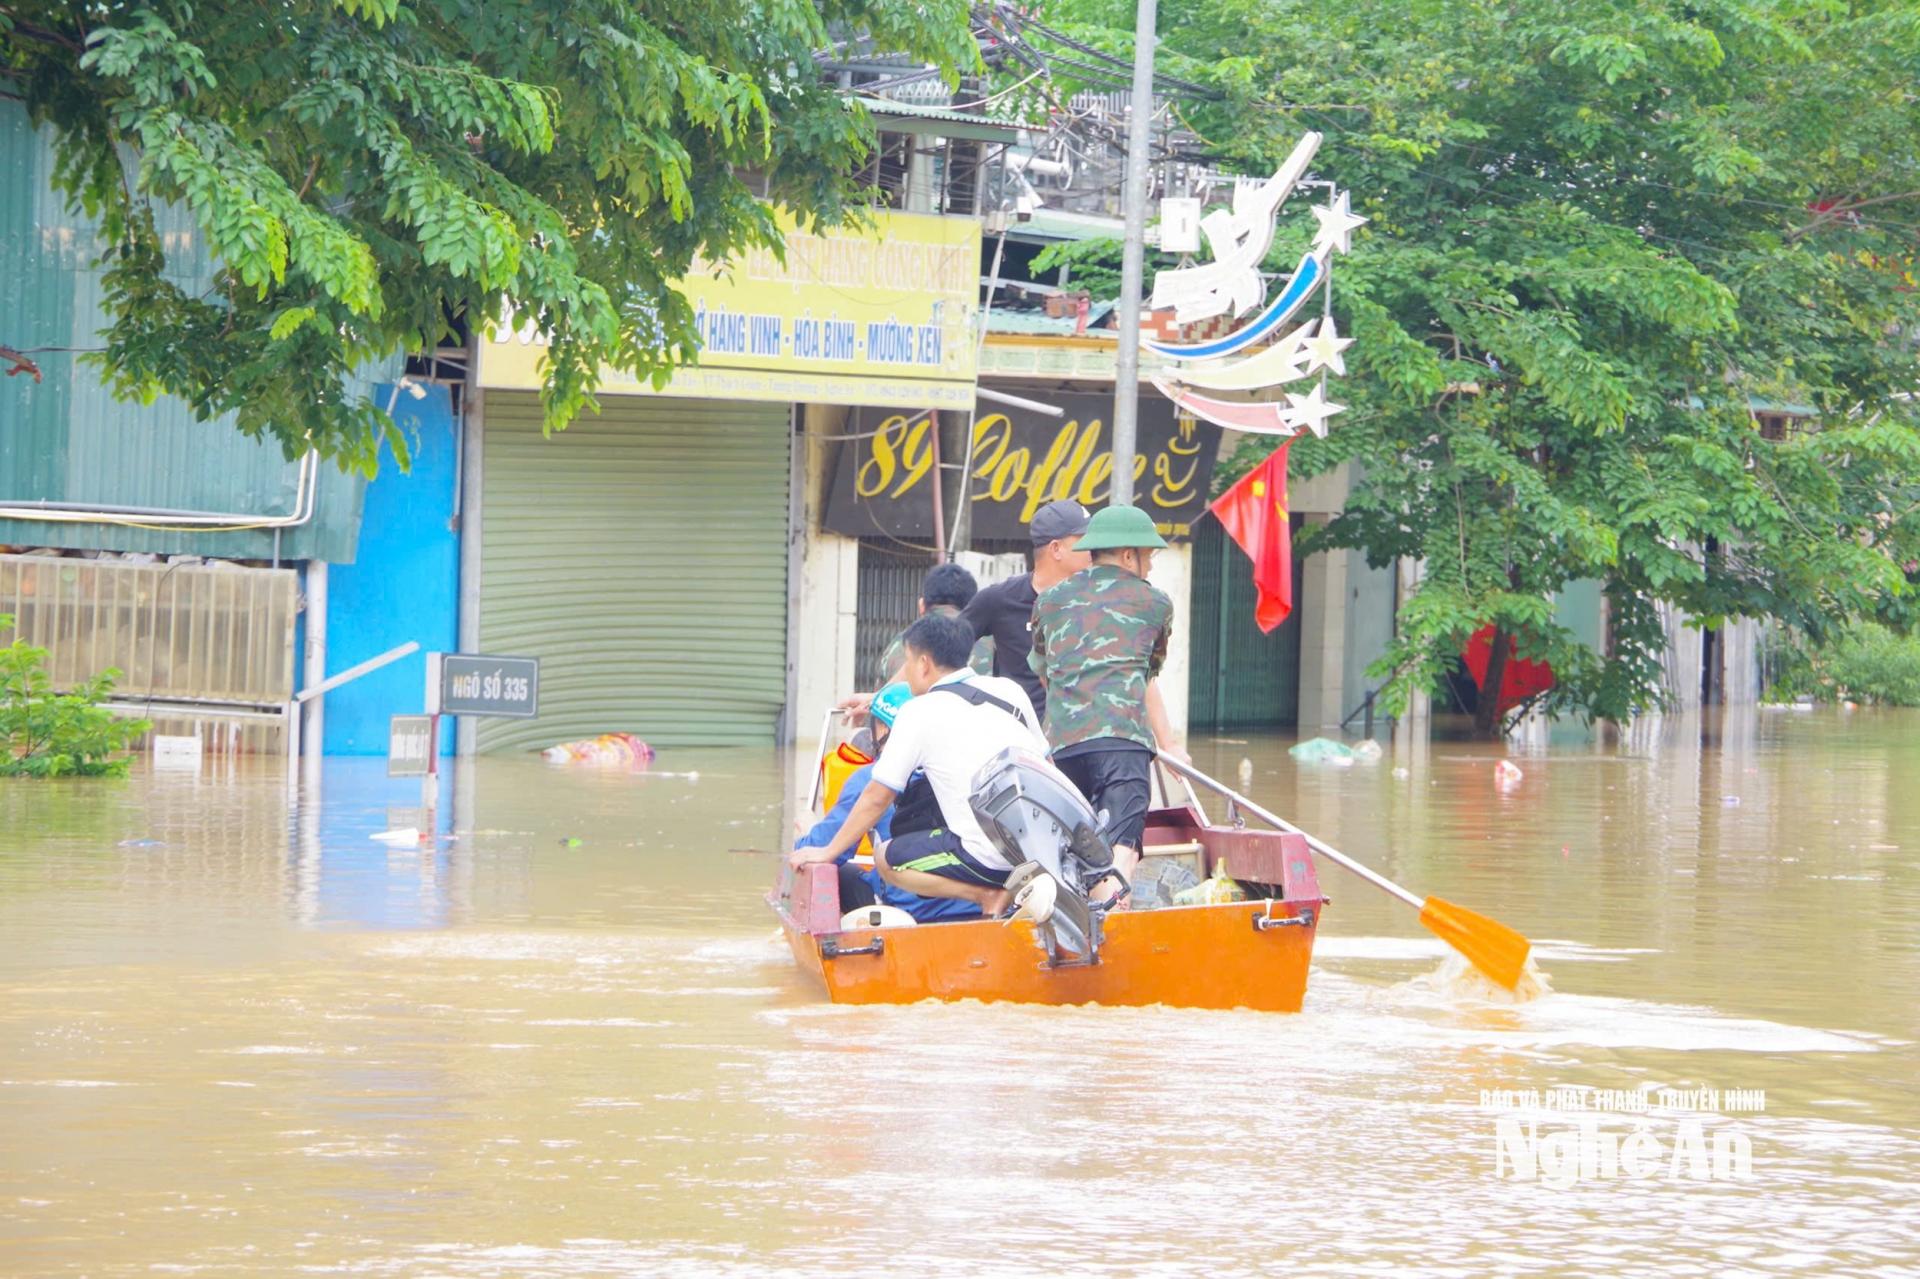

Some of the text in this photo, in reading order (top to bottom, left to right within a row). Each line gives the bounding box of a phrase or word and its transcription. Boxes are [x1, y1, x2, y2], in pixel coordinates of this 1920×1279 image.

[749, 314, 782, 356] VINH
[823, 311, 855, 360] BÌNH
[856, 414, 933, 499] 89
[483, 667, 503, 700] SỐ
[503, 676, 529, 701] 335
